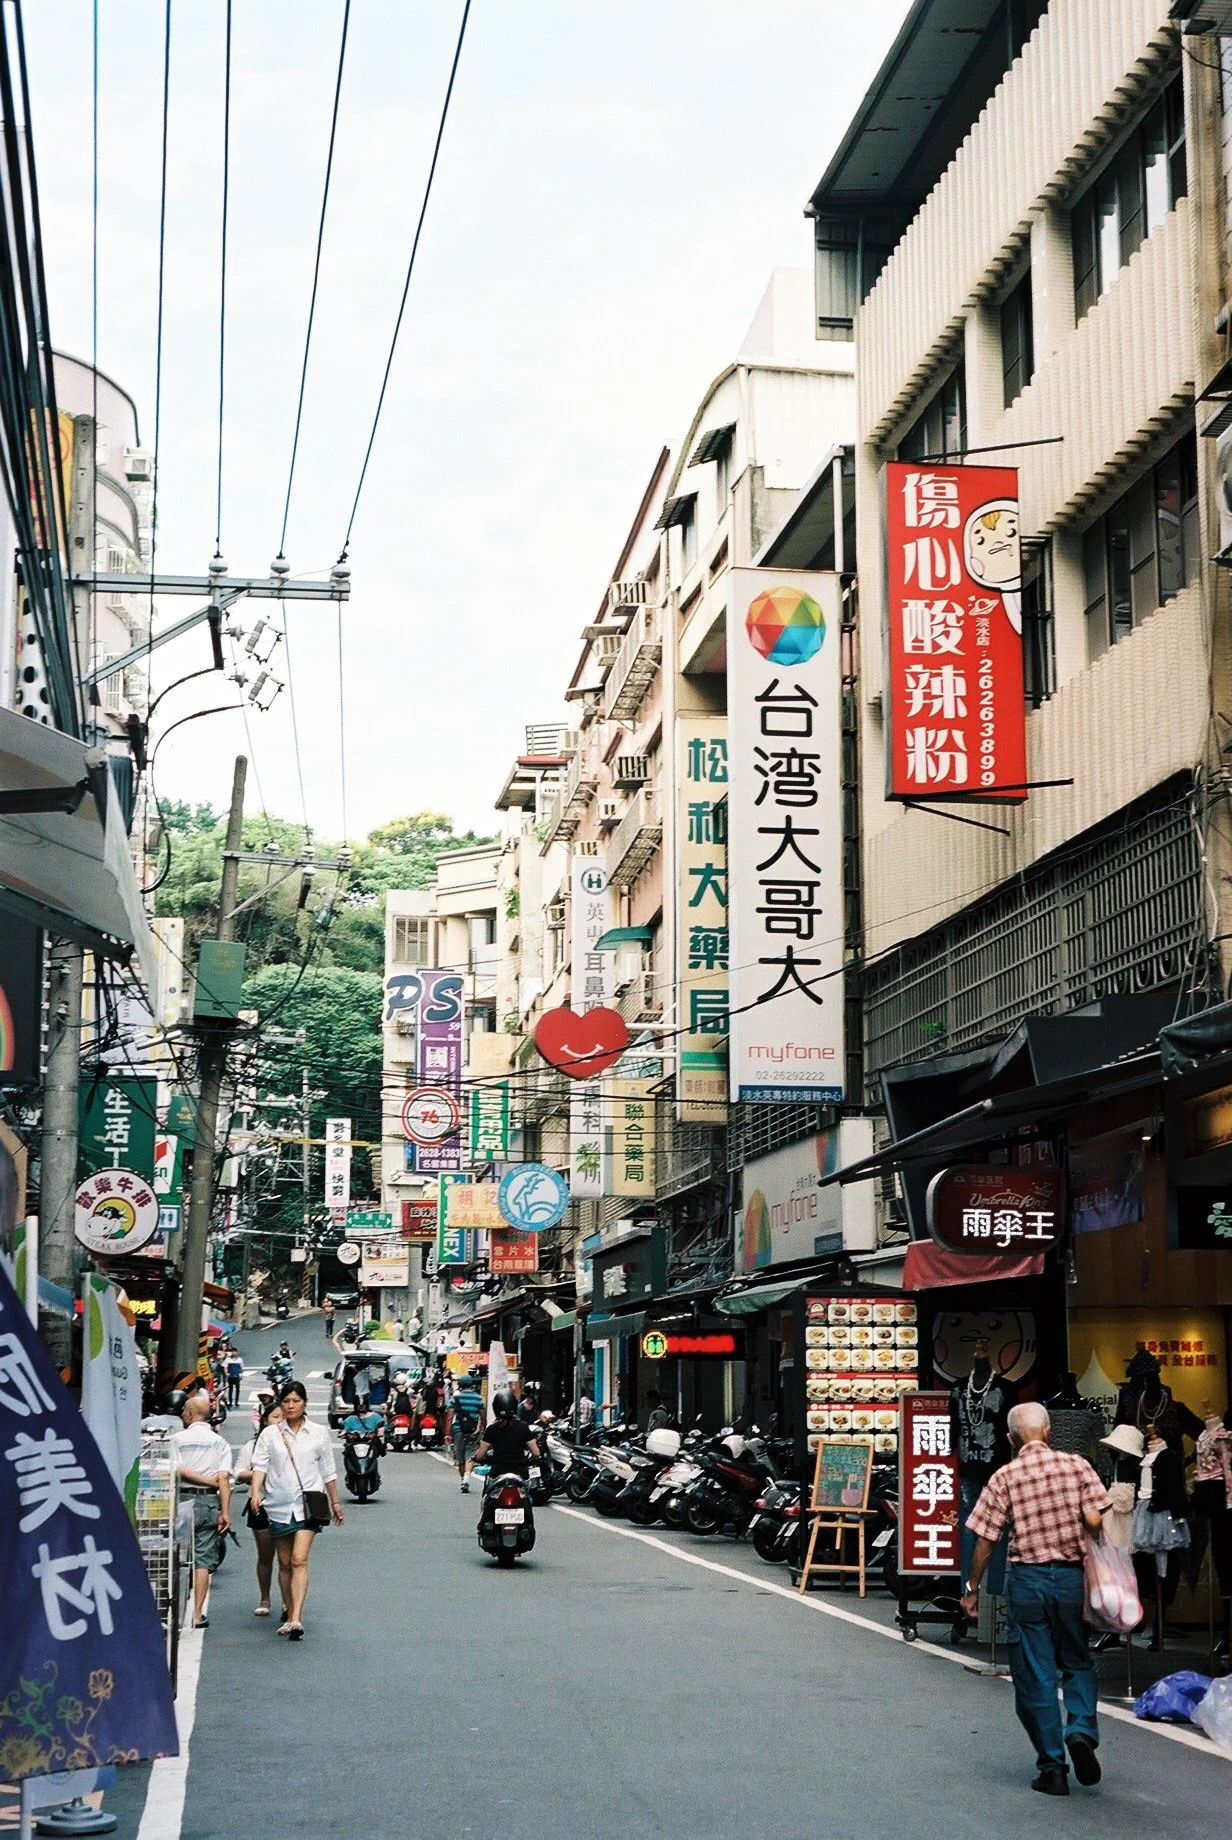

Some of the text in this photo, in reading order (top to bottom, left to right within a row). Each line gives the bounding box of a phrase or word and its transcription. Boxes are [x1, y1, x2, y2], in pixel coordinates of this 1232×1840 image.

[901, 473, 967, 784] 傷心酸辣粉
[688, 737, 729, 1035] 松和大藥局
[384, 974, 465, 1022] PS
[748, 1043, 835, 1062] myfone
[742, 1089, 842, 1101] 淡水英專特約服務中心
[756, 1070, 825, 1081] 02-26292222
[625, 1103, 644, 1182] 聯合藥局
[771, 1190, 818, 1233] myfone
[962, 1208, 1055, 1247] 雨傘王
[912, 1414, 954, 1566] 雨傘王
